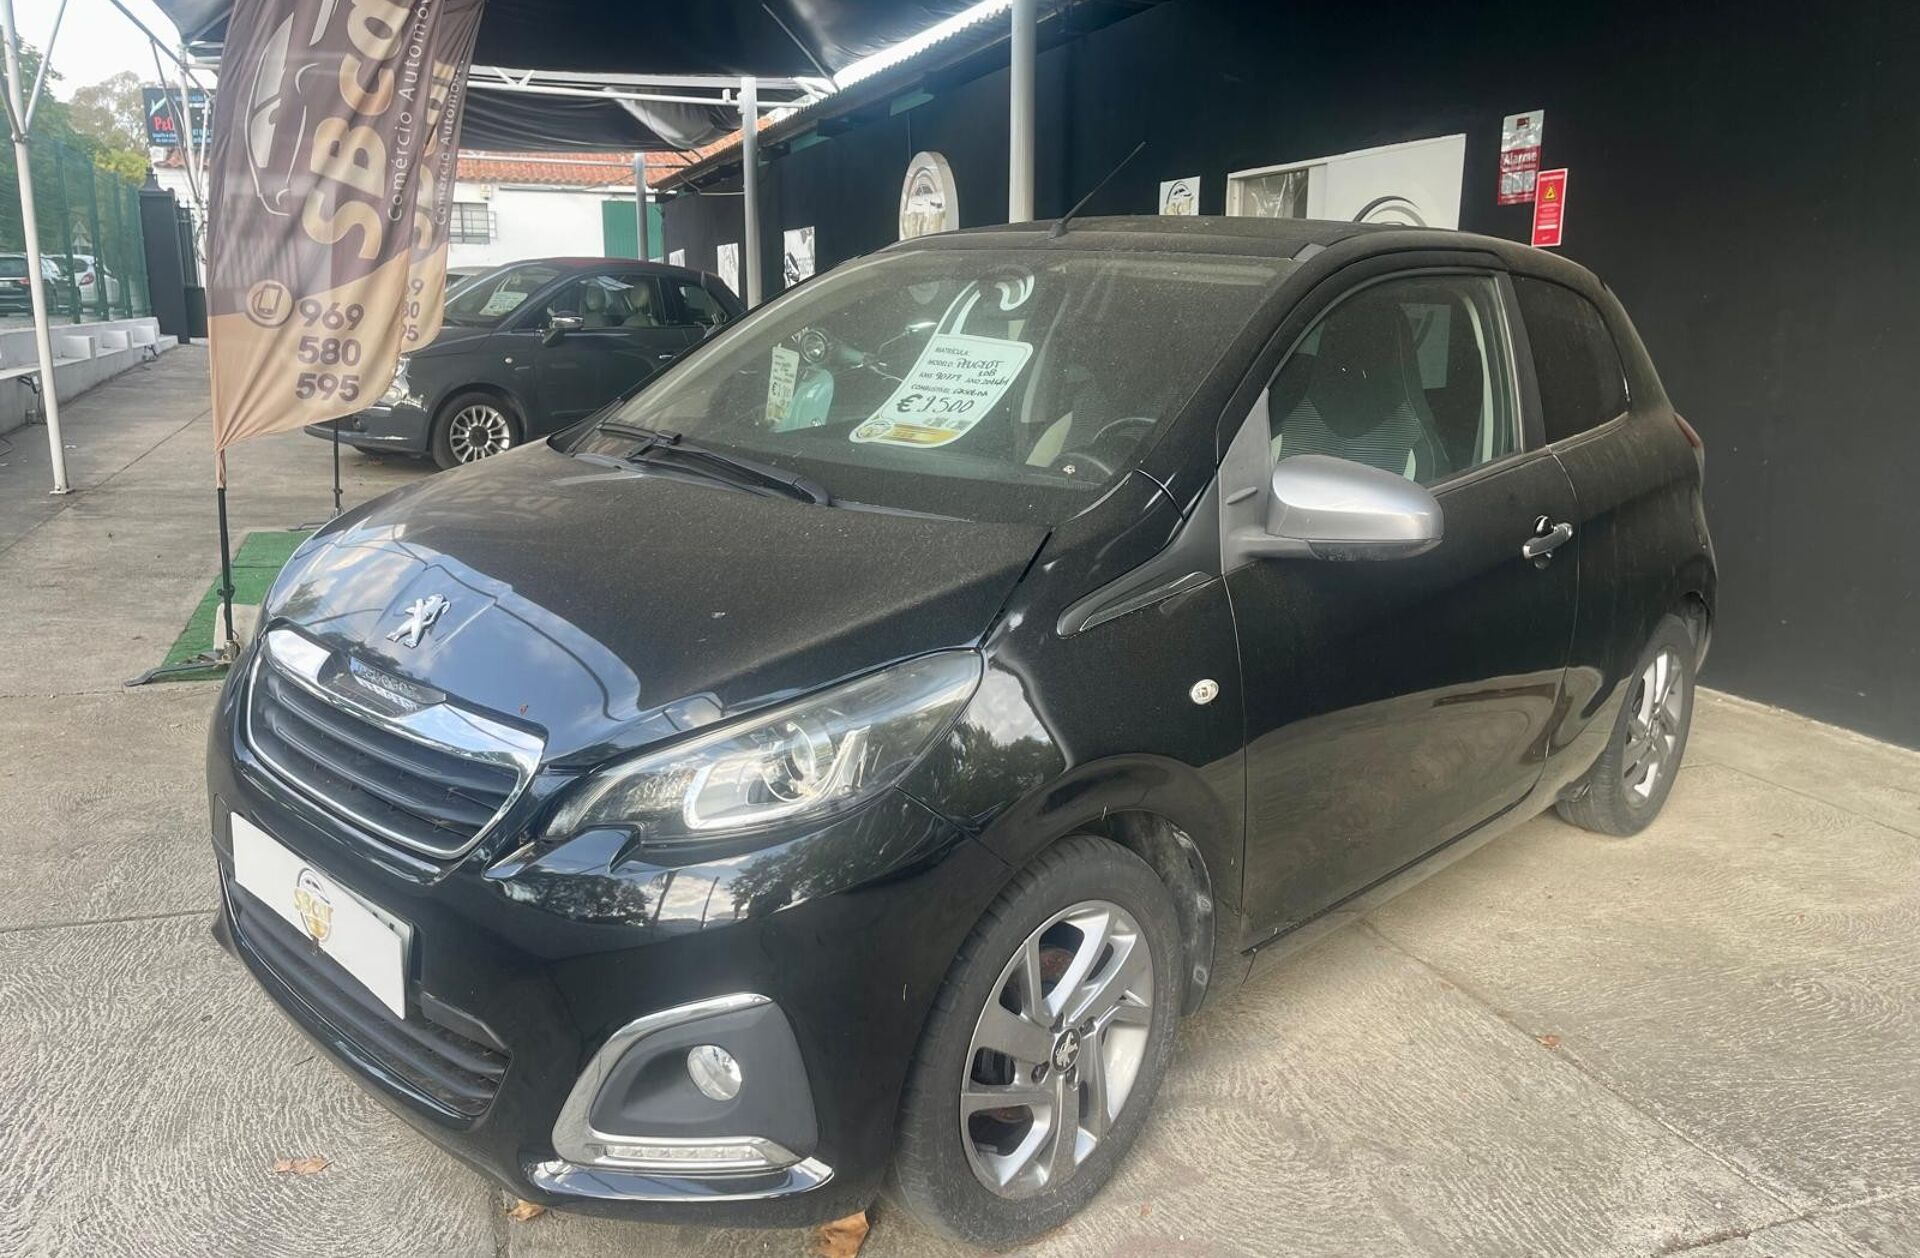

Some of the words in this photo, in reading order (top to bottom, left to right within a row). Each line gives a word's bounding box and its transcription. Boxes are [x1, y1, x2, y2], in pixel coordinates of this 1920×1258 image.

[387, 111, 413, 222] Comércio
[299, 298, 365, 331] 969
[298, 335, 362, 367] 580
[295, 372, 360, 402] 595
